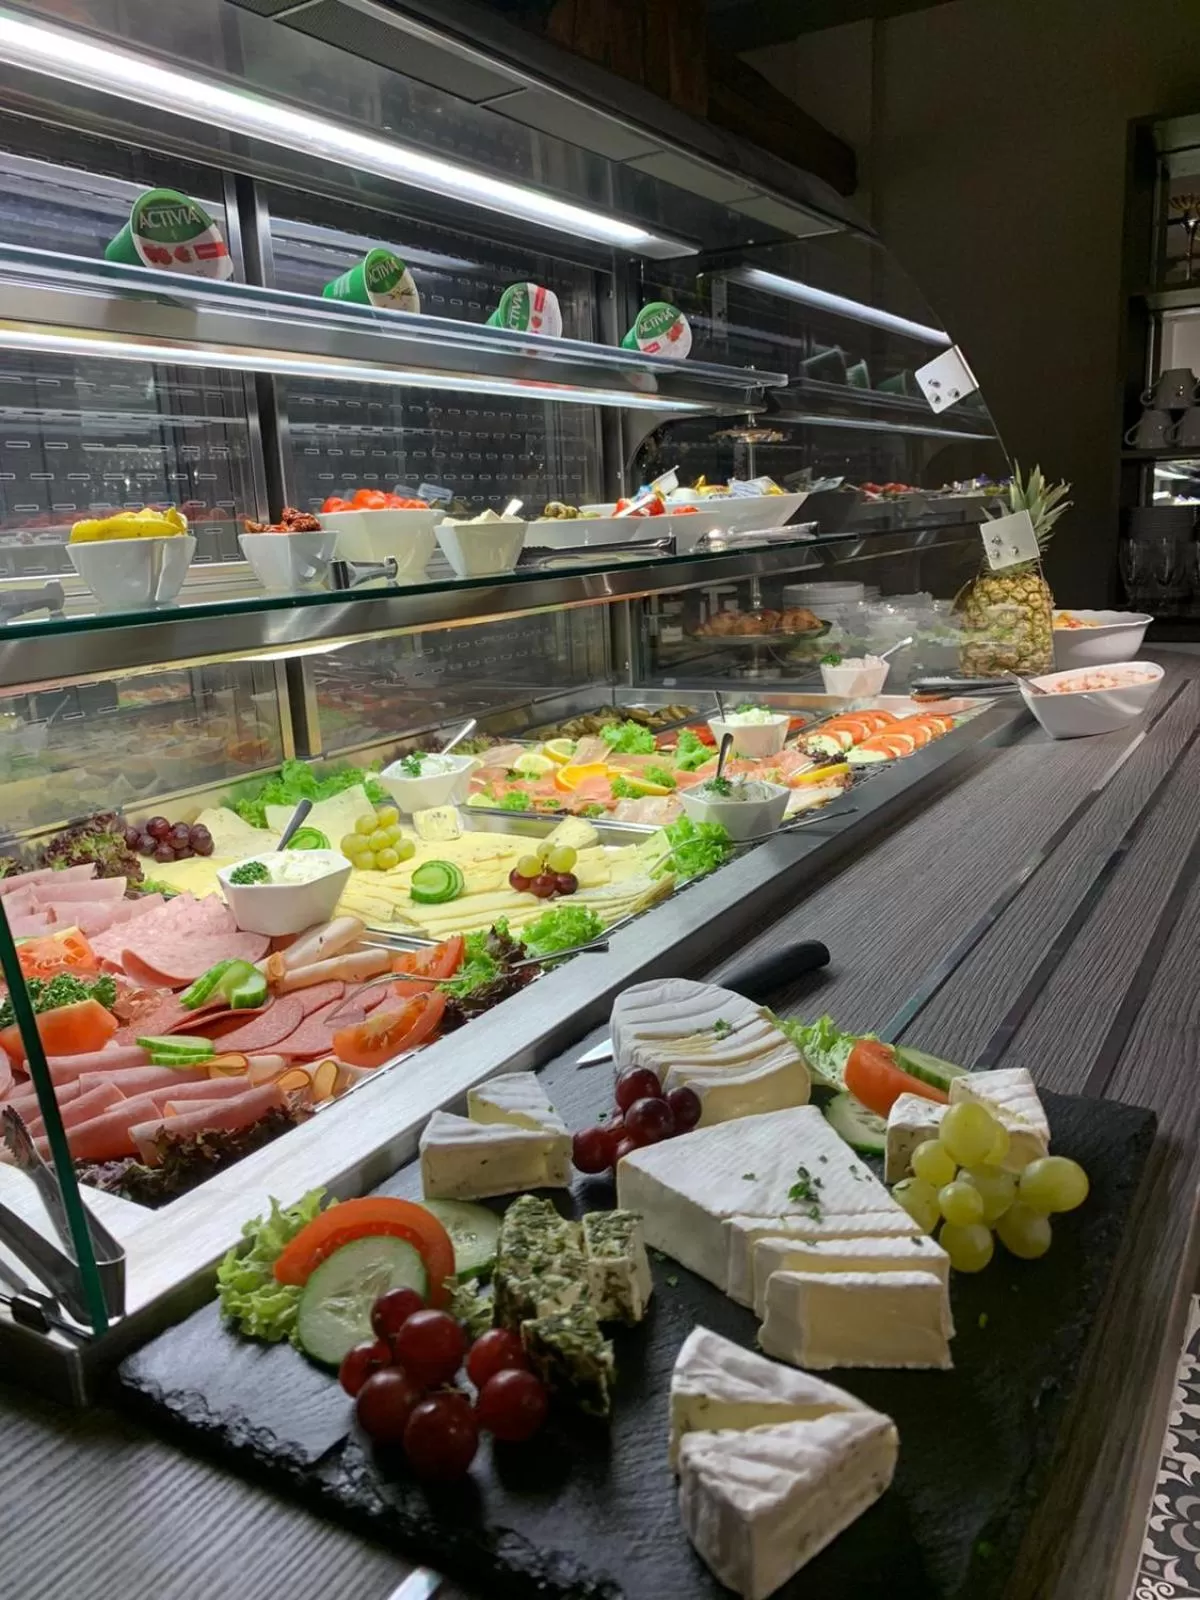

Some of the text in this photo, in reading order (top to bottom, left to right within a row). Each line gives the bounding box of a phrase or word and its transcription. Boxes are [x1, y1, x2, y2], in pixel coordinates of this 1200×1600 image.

[140, 206, 201, 229] ACTIVIA
[509, 290, 524, 329] CTIVIA
[639, 307, 674, 334] ACTIVIA
